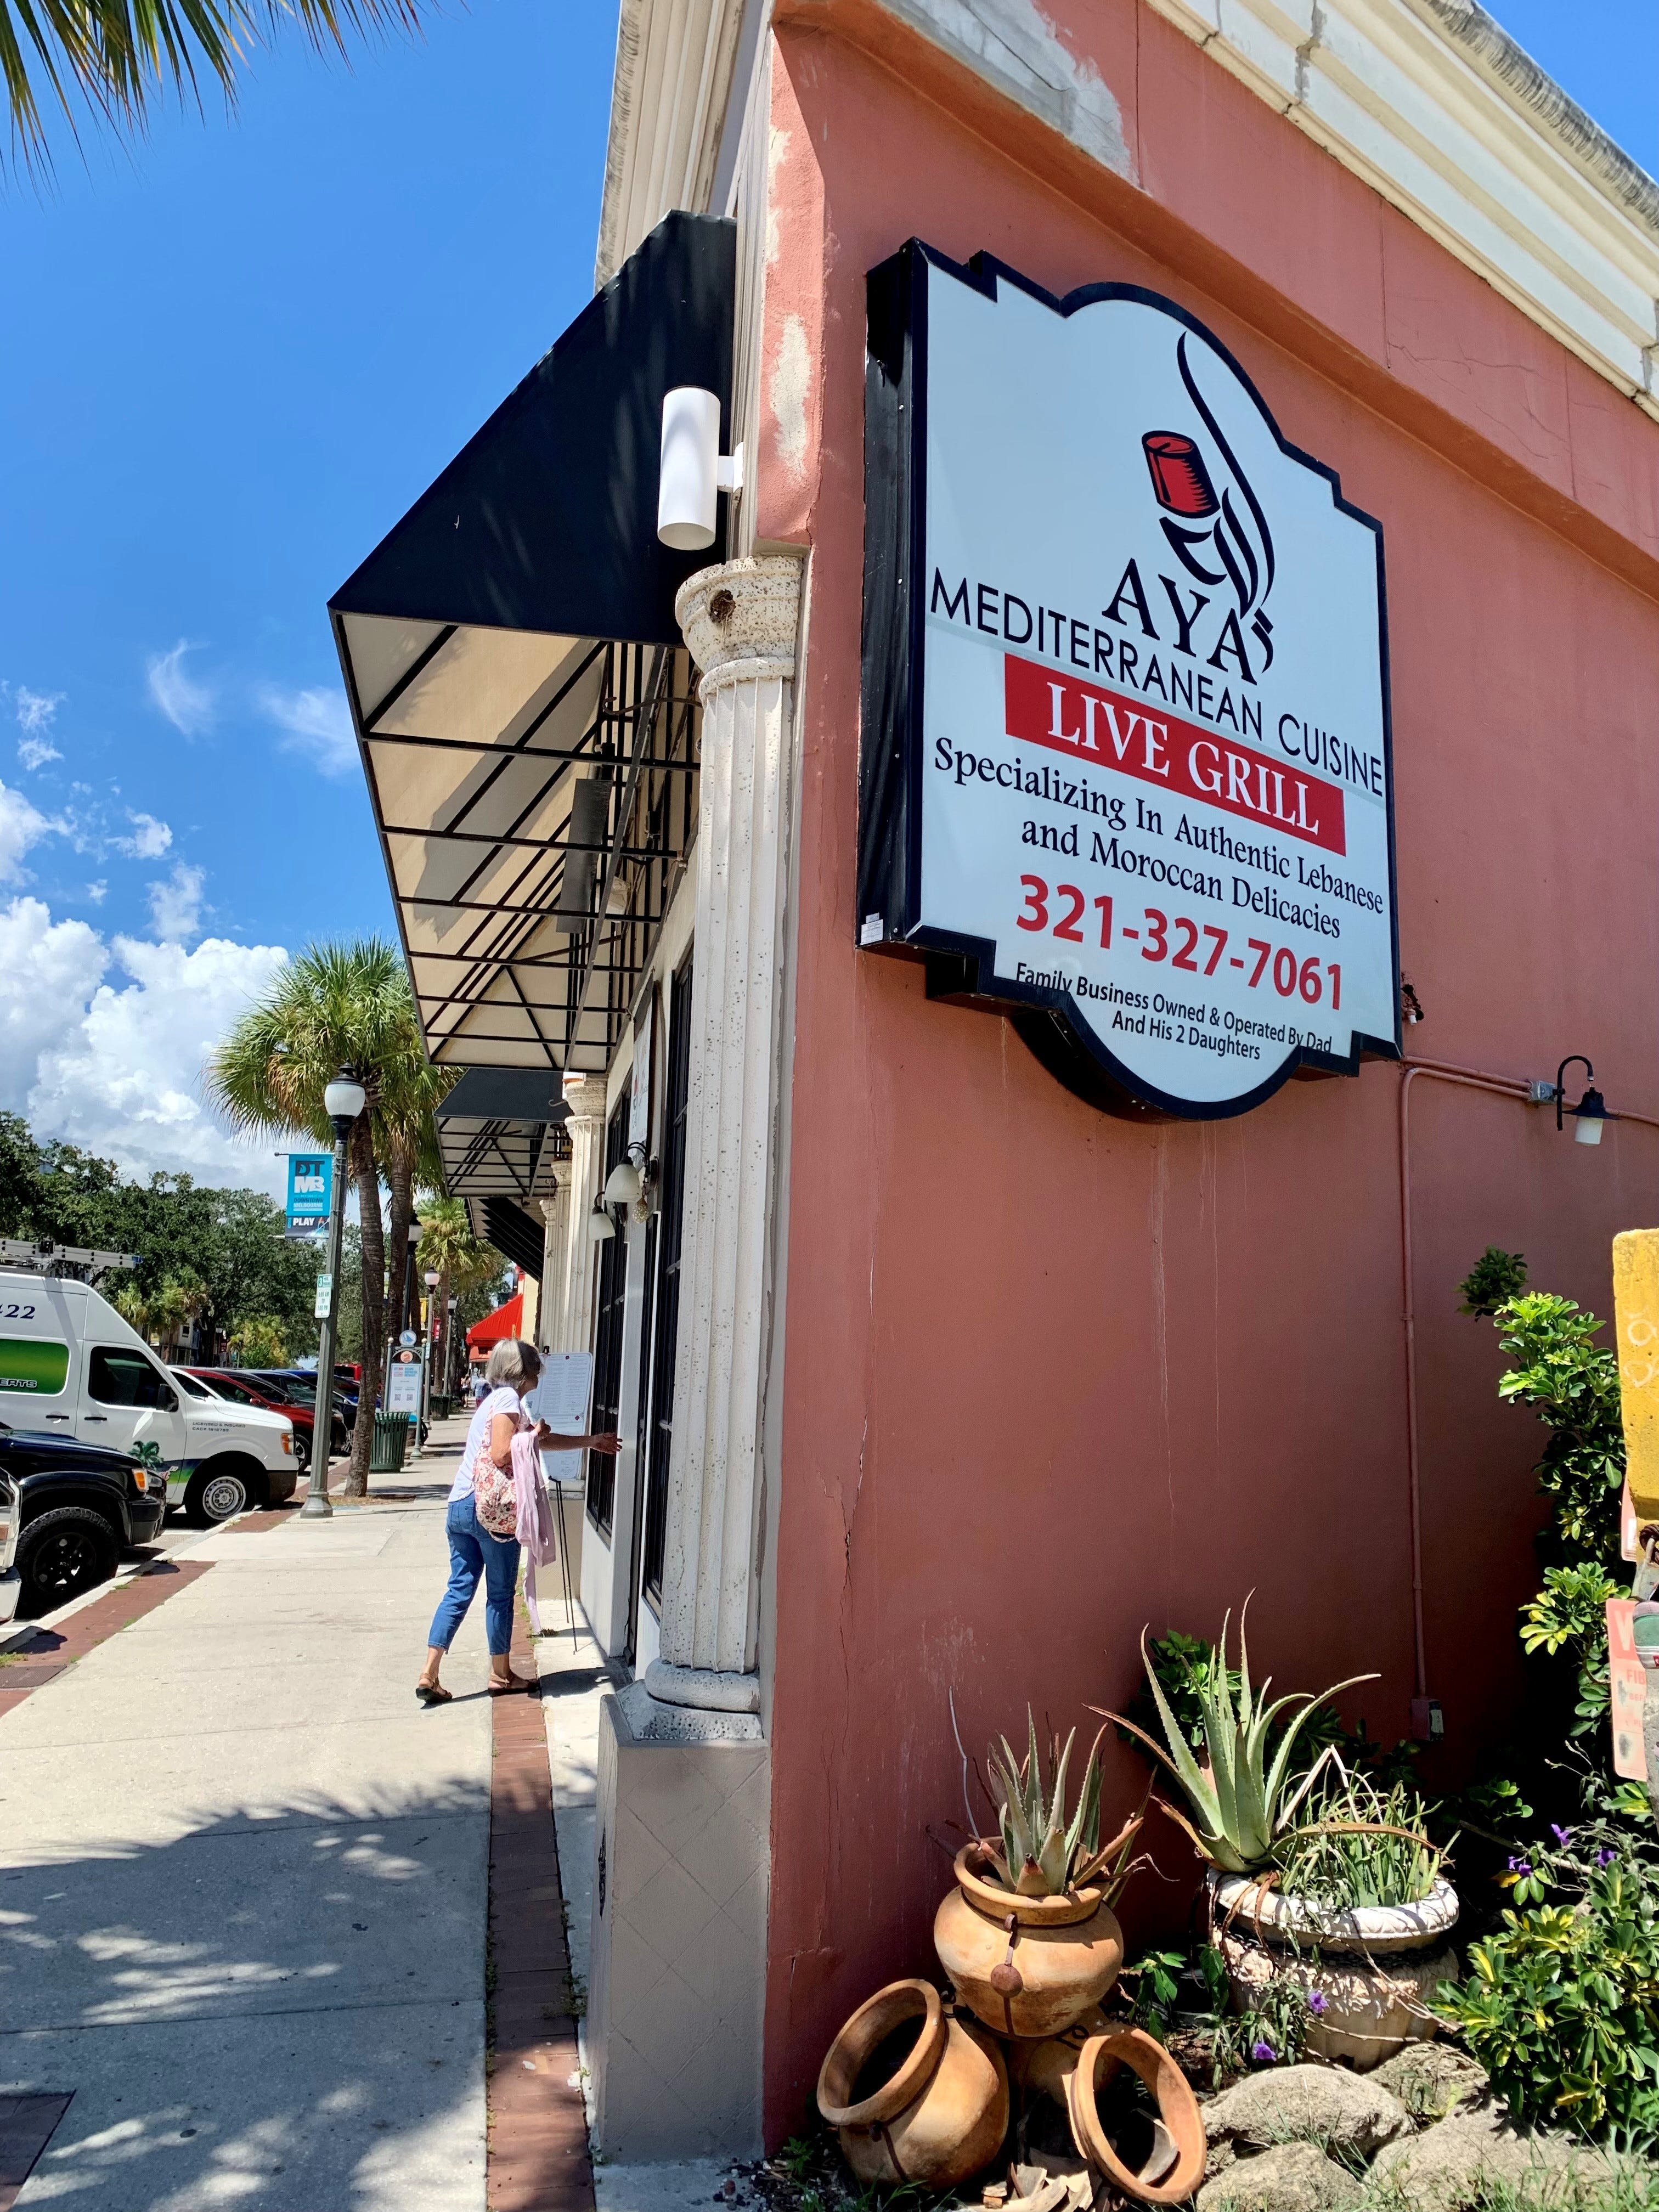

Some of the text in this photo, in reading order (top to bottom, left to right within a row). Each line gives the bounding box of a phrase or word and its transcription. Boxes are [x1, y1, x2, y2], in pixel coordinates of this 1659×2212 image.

[931, 567, 1383, 797] MEDITERRANEAN CUISINE
[1046, 682, 1319, 836] LIVE GRILL
[935, 738, 1383, 913] Specializing In Authentic Lebanese
[1022, 820, 1340, 938] and Moroccan Delicacies
[1017, 876, 1339, 1008] 321-327-7061
[1016, 962, 1332, 1052] Family Business Owned & Operated By Dad
[1112, 1011, 1260, 1059] And His 2 Daughters
[294, 1176, 325, 1193] MB
[295, 1161, 325, 1176] DT
[293, 1217, 315, 1226] PLAY
